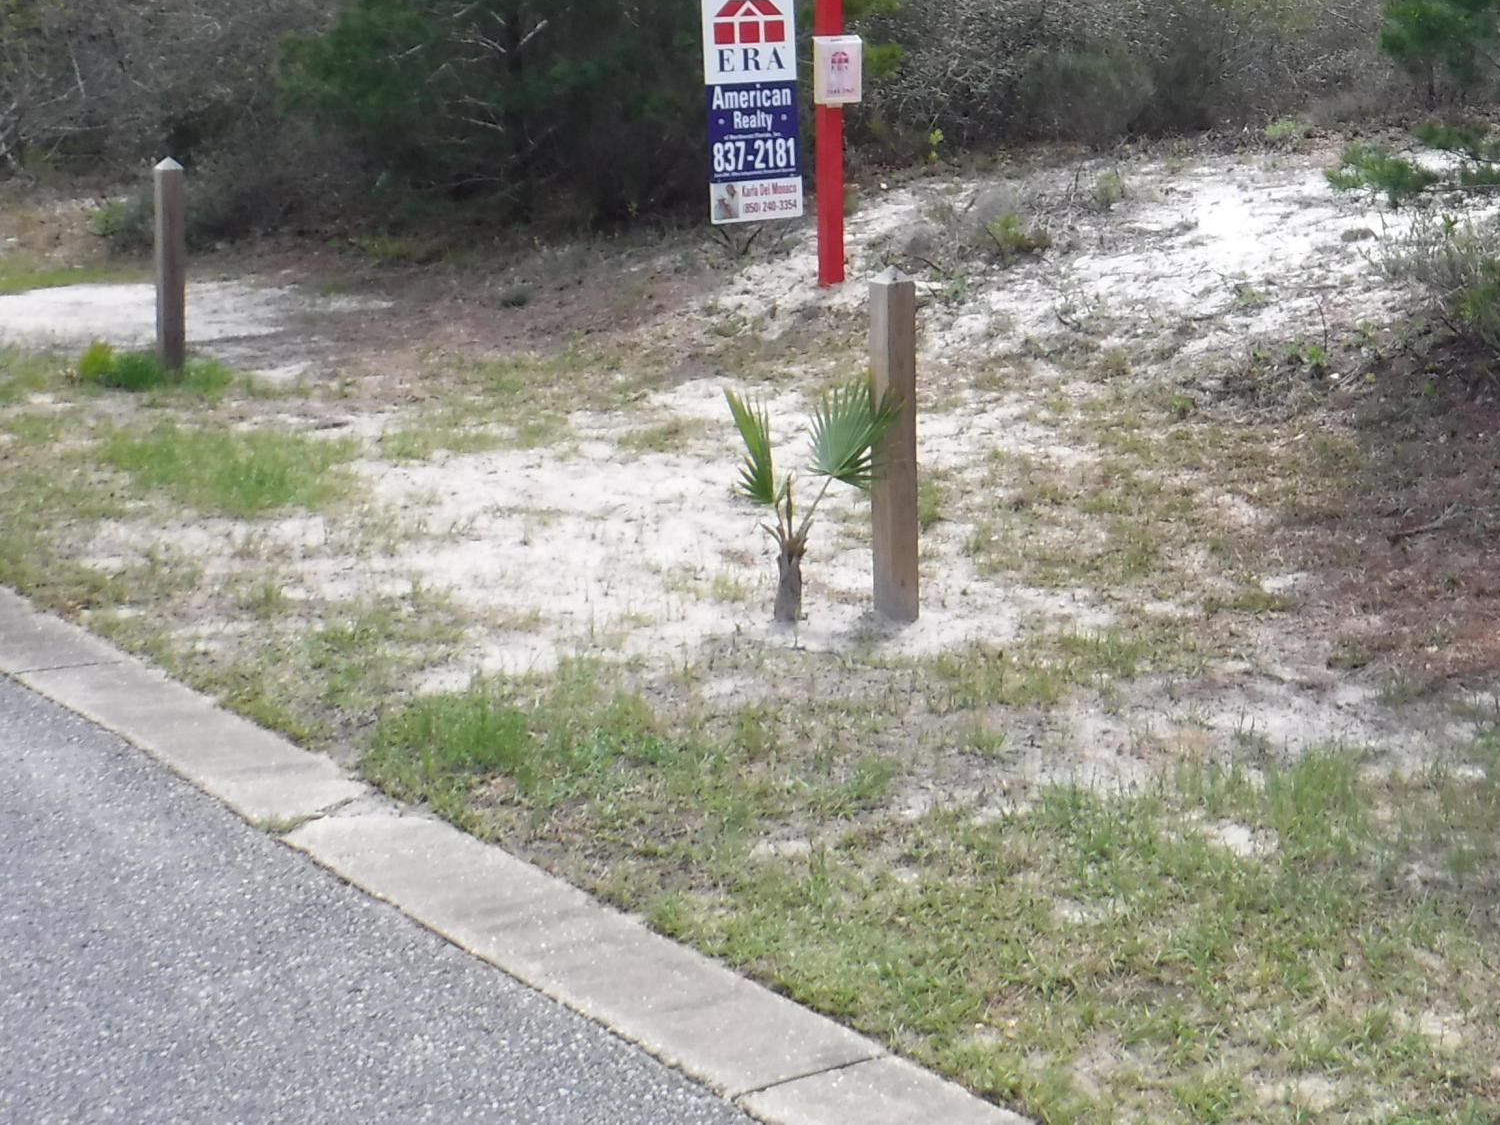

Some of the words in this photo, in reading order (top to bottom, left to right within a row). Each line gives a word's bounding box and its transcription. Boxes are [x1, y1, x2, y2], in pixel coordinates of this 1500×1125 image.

[717, 46, 785, 73] ERA
[712, 83, 792, 110] American
[733, 109, 773, 131] Realty
[713, 137, 796, 172] 837-2181
